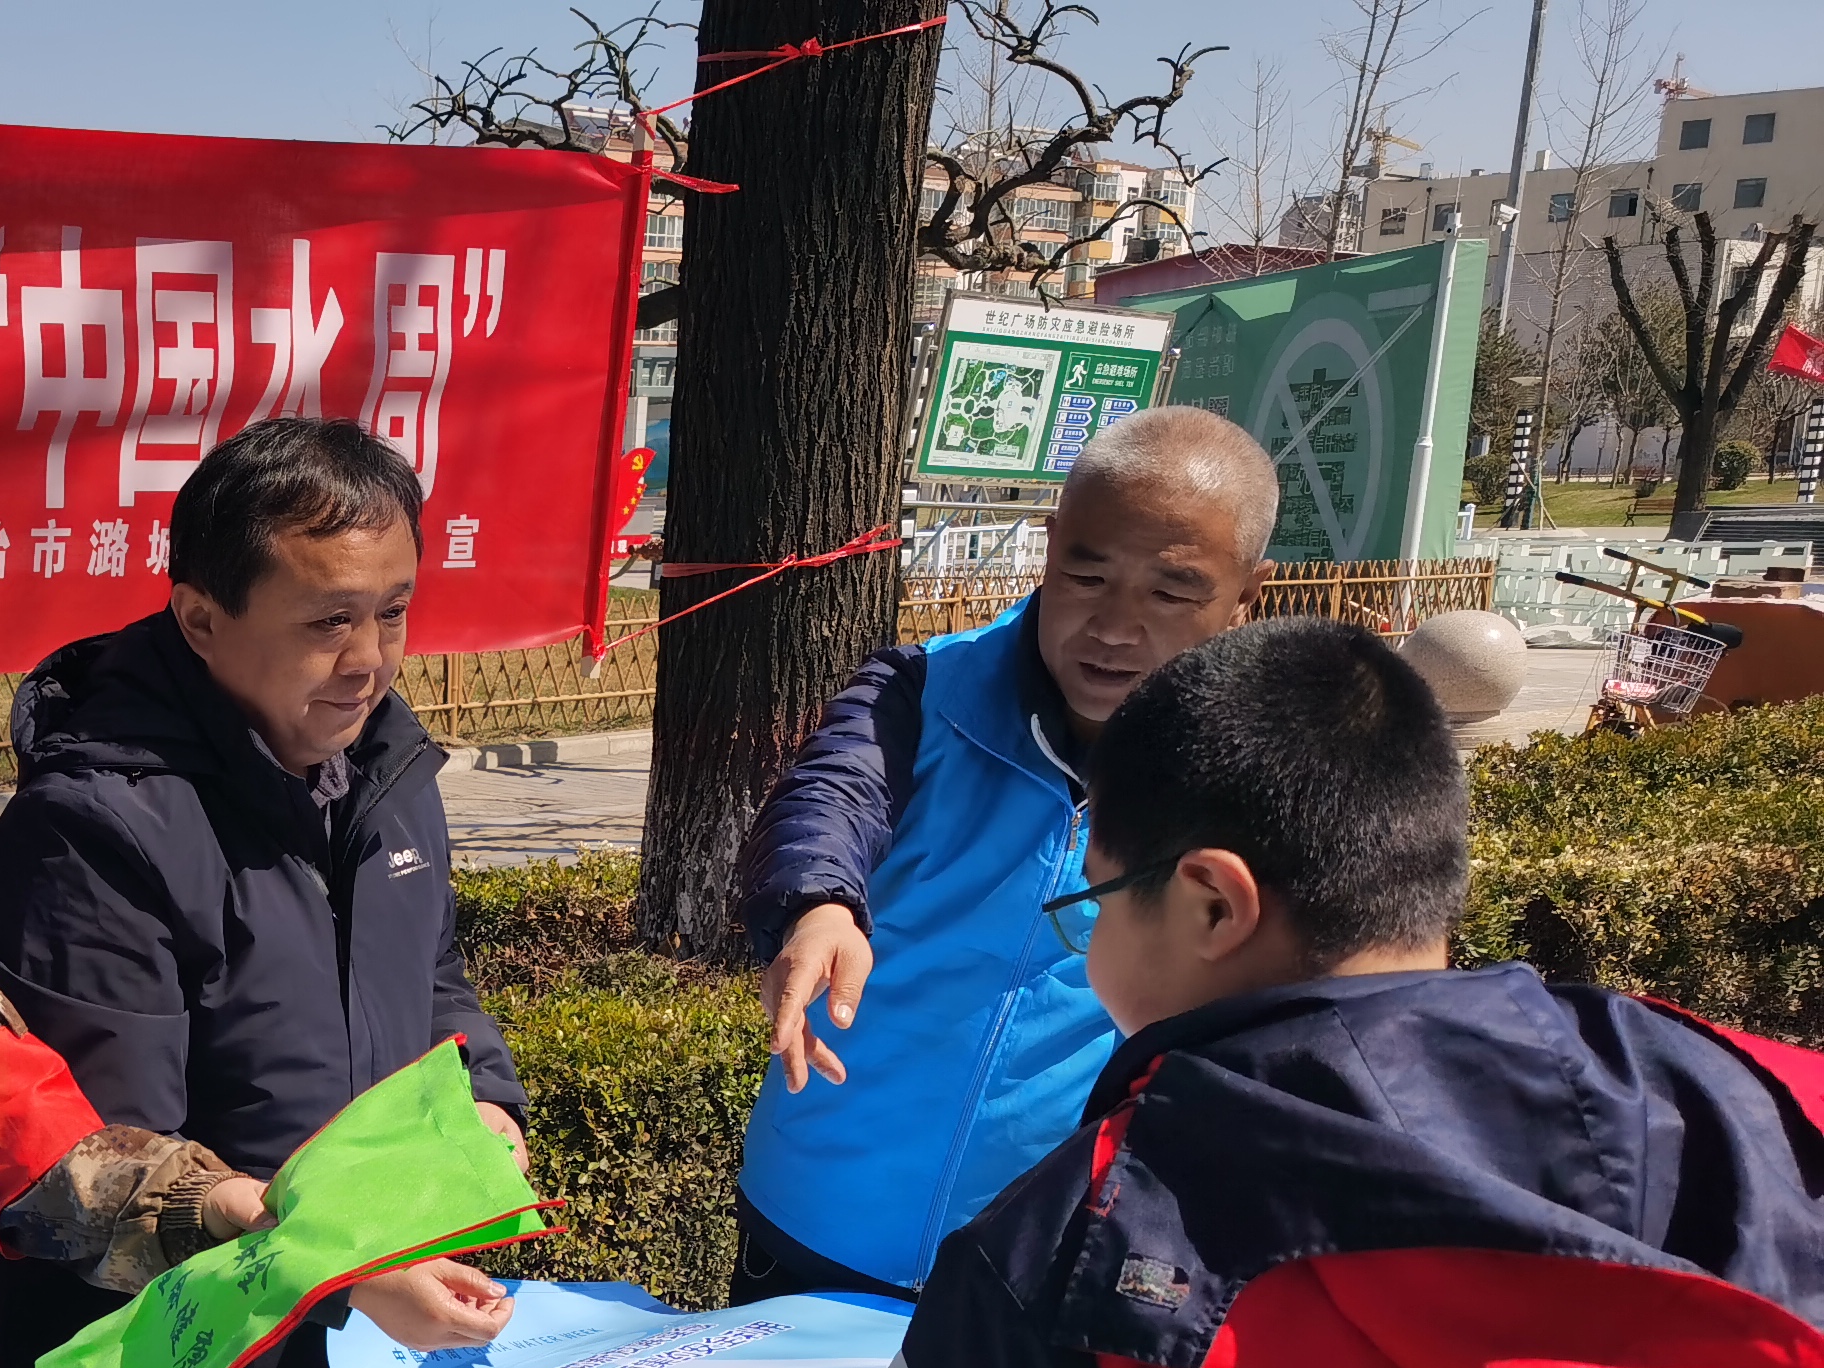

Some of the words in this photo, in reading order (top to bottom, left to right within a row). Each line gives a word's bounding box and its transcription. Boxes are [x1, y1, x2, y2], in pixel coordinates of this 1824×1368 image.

[985, 309, 1136, 340] 世纪广场防灾应急避险场所
[442, 515, 480, 569] 宣
[508, 1335, 558, 1352] WATER
